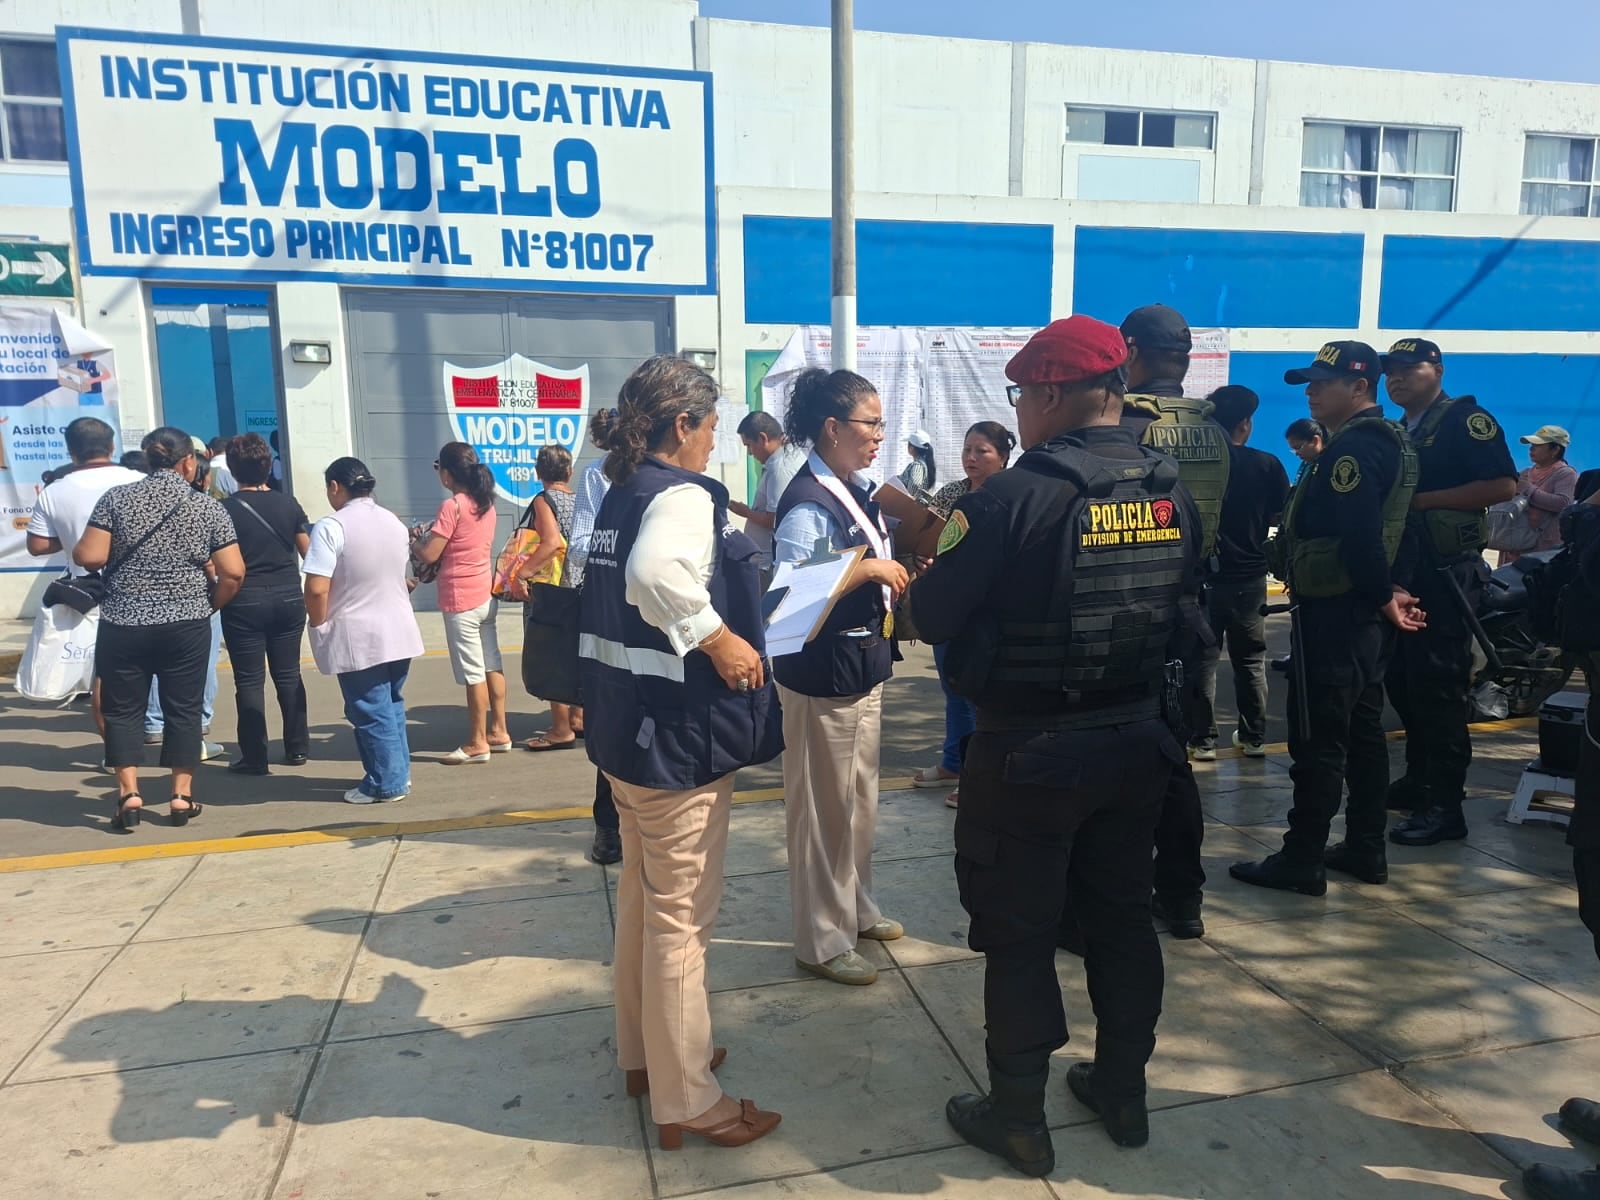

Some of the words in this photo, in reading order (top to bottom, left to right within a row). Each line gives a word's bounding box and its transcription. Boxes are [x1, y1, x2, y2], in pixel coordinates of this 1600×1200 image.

[100, 55, 410, 113] INSTITUCIÓN
[424, 75, 671, 130] EDUCATIVA
[213, 117, 601, 218] MODELO
[109, 212, 275, 257] INGRESO
[284, 219, 473, 265] PRINCIPAL
[0, 333, 62, 344] nvenido
[12, 348, 48, 359] local
[0, 362, 47, 373] tación
[520, 389, 524, 397] Y
[510, 399, 536, 408] 81007
[13, 424, 56, 435] Asiste
[466, 416, 576, 446] MODELO
[1155, 427, 1217, 447] POLICIA
[13, 440, 45, 448] desde
[15, 452, 45, 460] hasta
[1090, 501, 1156, 532] POLICIA
[1082, 532, 1120, 547] DIVISION
[1123, 531, 1133, 543] DE
[1136, 527, 1181, 543] EMERGENCIA
